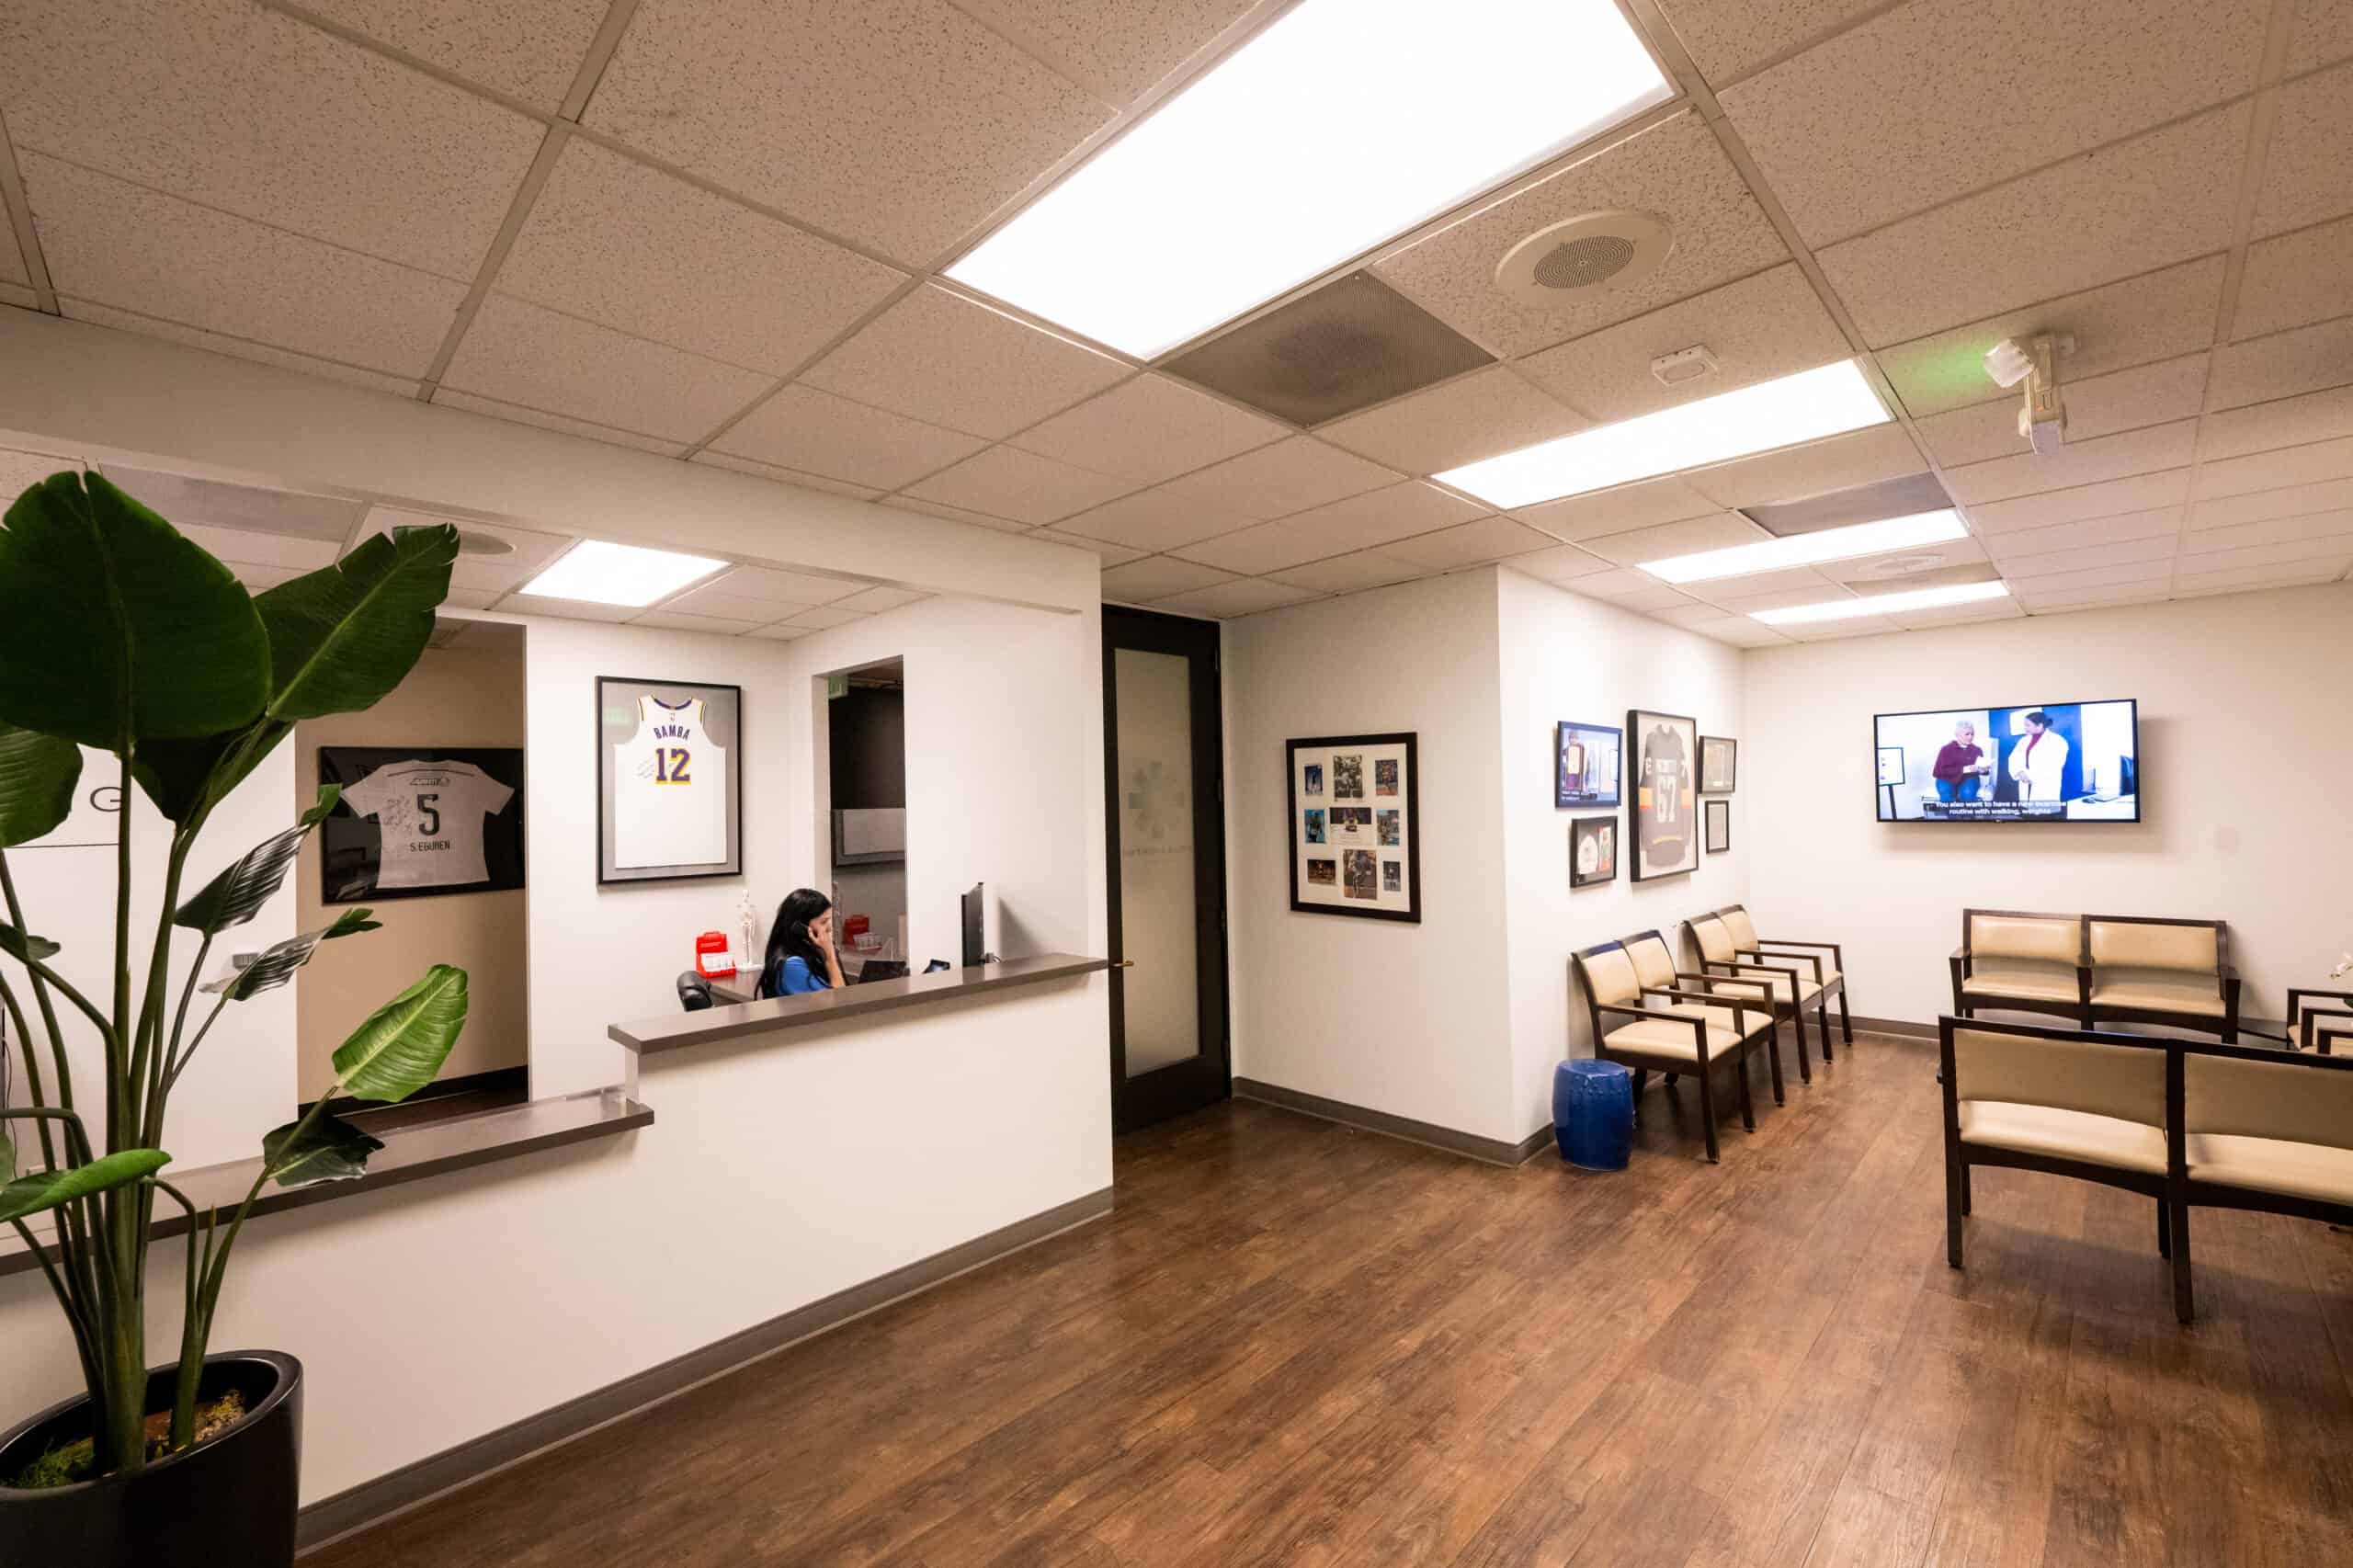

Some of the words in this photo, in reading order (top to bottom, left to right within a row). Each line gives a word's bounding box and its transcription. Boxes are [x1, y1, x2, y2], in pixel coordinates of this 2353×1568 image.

[654, 724, 690, 740] BAMBA
[655, 747, 692, 785] 12
[417, 794, 440, 835] 5
